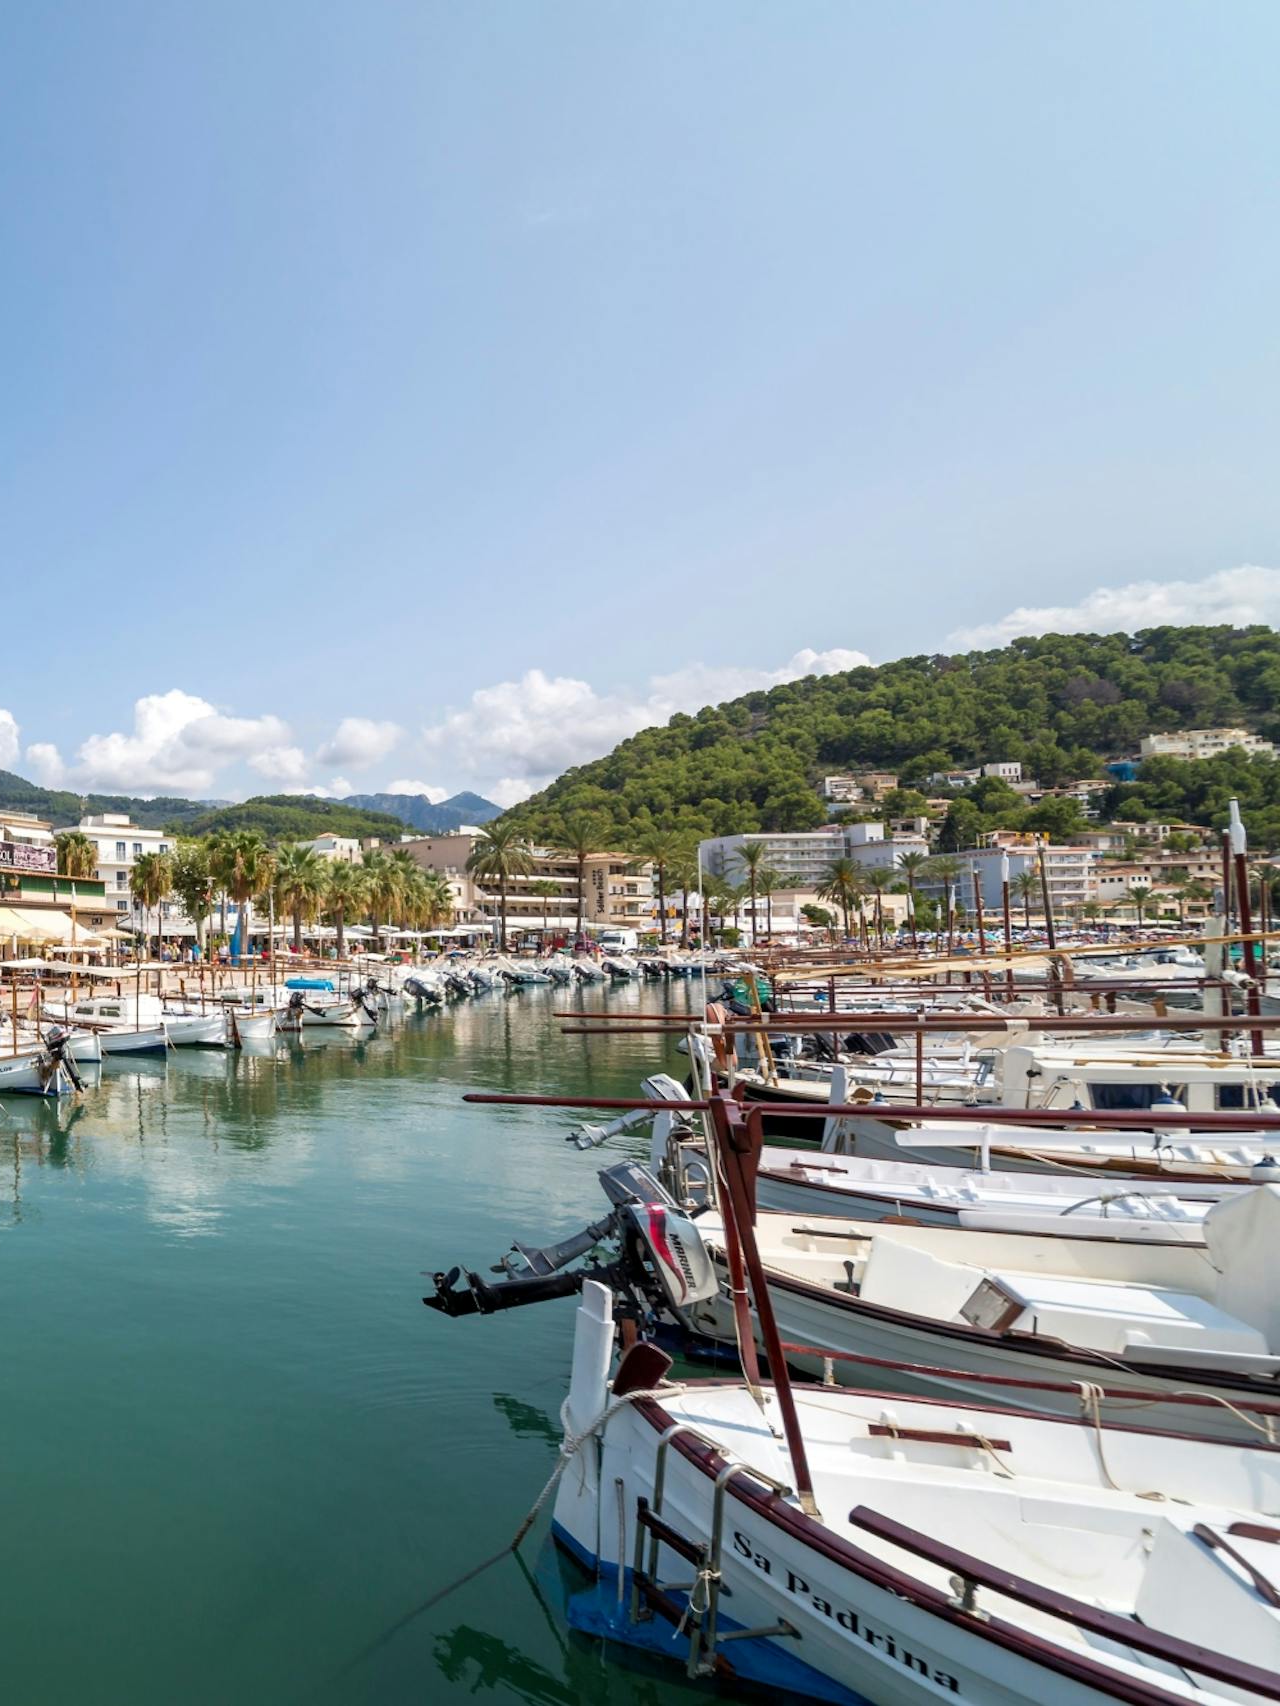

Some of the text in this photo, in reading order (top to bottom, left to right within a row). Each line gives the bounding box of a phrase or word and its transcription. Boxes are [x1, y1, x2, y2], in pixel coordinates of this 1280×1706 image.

[669, 1233, 697, 1289] MARINER
[733, 1531, 961, 1695] Sa Padrina
